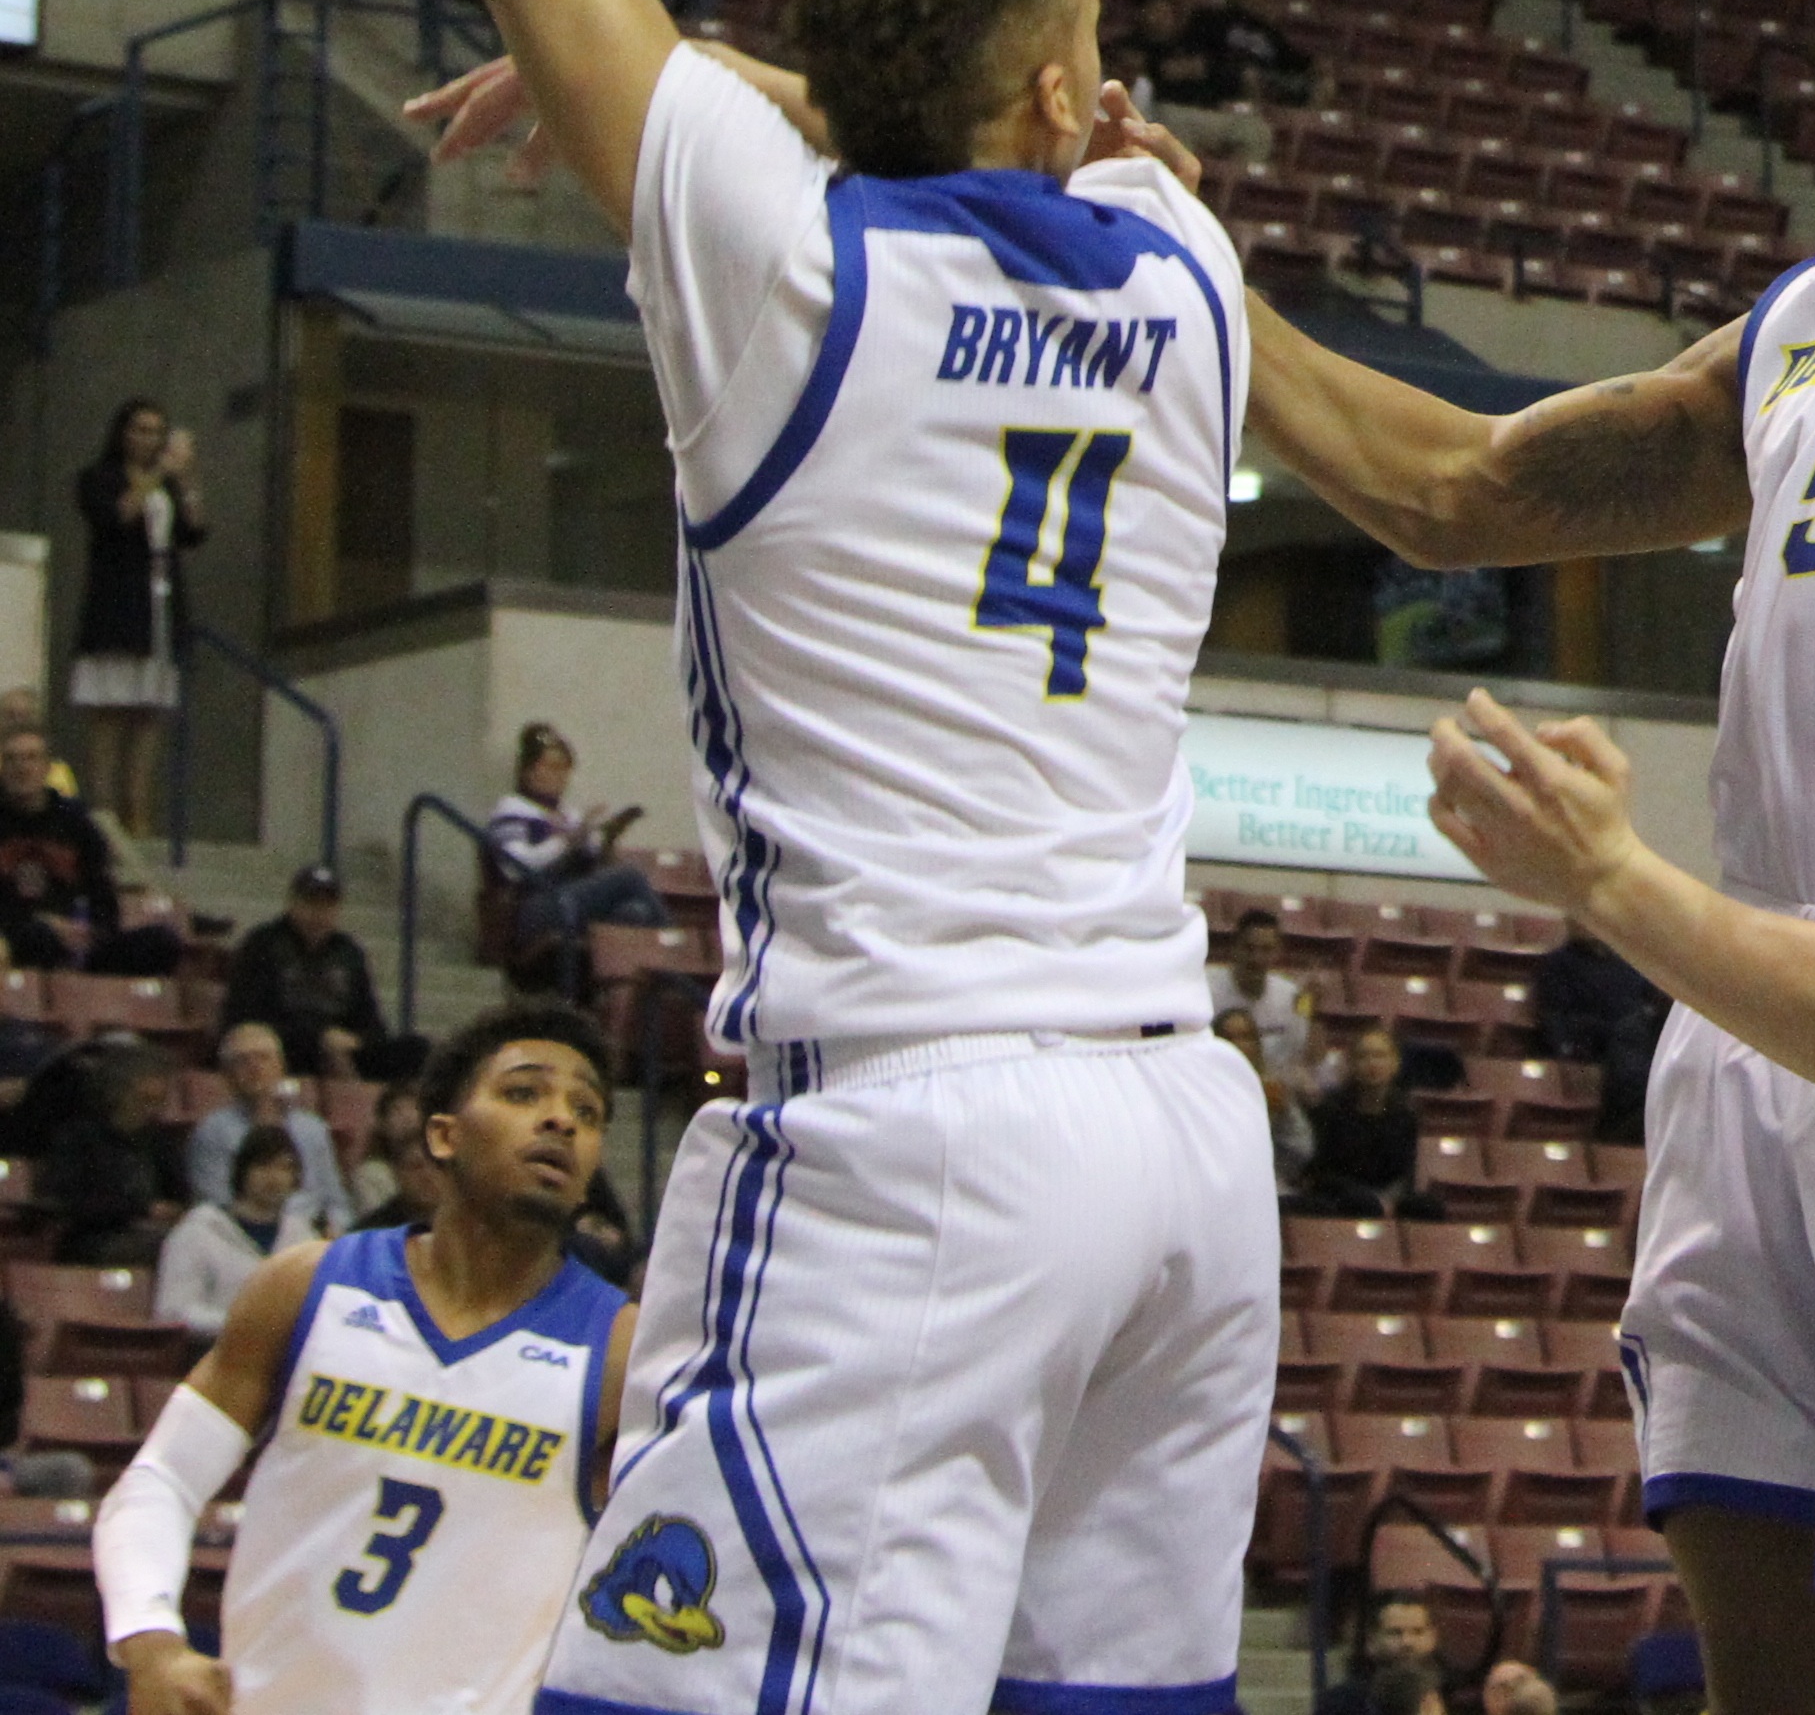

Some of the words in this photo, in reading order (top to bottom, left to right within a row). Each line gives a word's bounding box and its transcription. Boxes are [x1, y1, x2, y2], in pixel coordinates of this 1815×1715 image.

[936, 304, 1177, 394] BRYANT
[970, 425, 1135, 704] 4
[1238, 812, 1332, 851] Better
[1295, 774, 1429, 821] Ingredie
[518, 1345, 569, 1369] CAA
[298, 1372, 567, 1486] DELAWARE
[332, 1476, 445, 1619] 3
